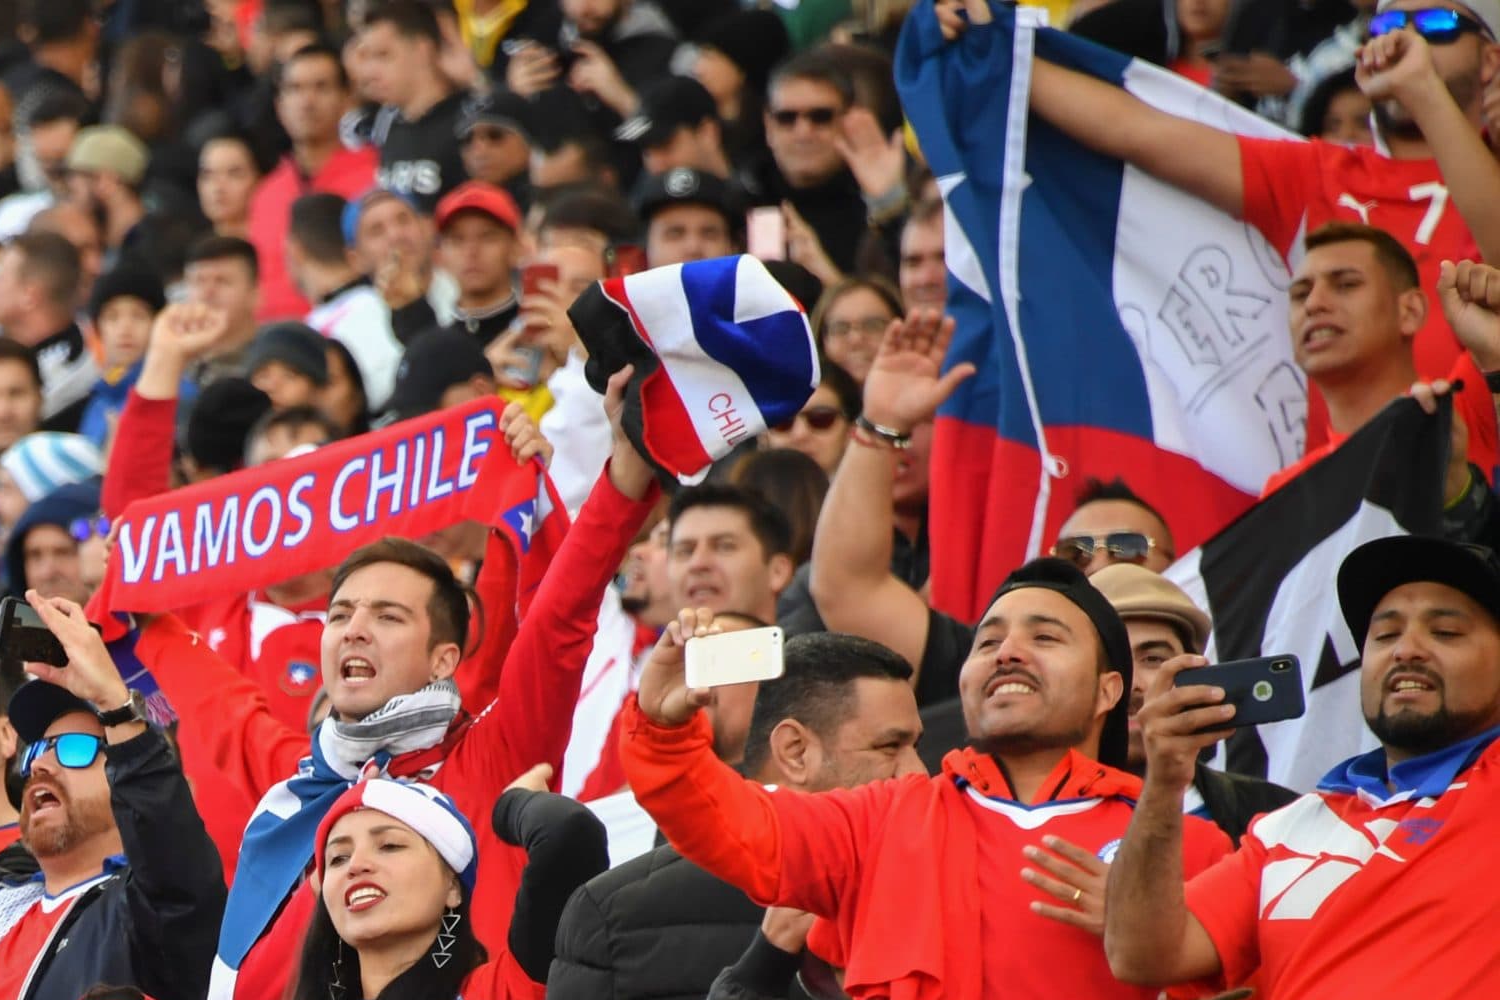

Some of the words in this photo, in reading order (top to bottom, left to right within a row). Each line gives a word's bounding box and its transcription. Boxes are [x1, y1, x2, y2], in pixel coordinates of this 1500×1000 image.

[1408, 181, 1449, 245] 7
[118, 472, 317, 583] VAMOS
[328, 410, 495, 532] CHILE
